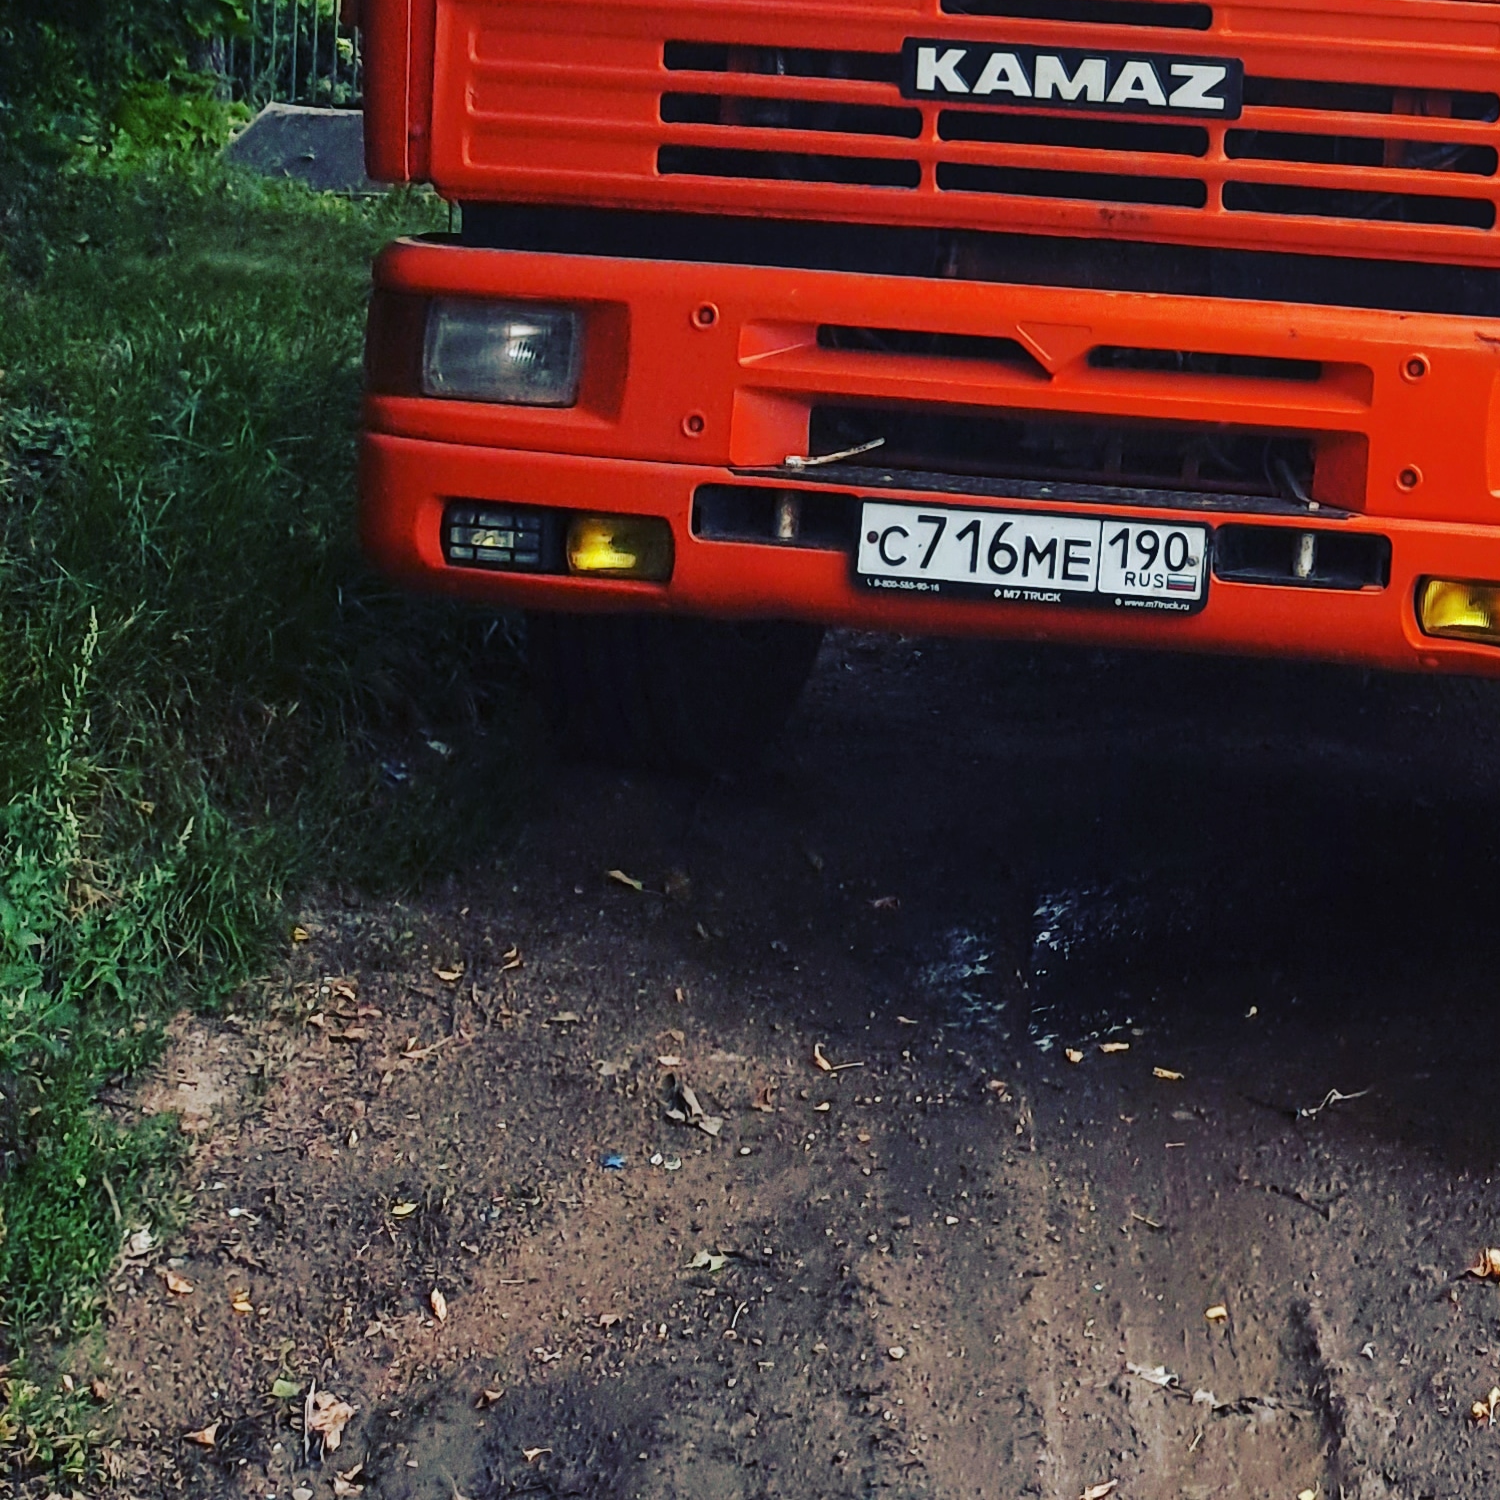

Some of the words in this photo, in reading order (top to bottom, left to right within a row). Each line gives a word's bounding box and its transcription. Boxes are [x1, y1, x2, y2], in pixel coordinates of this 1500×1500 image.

[916, 47, 1227, 110] KAMAZ
[1109, 527, 1189, 571] 190
[1125, 571, 1164, 589] RUS
[1003, 589, 1021, 600] M7
[1023, 590, 1062, 602] TRUCK
[1124, 599, 1190, 611] www.m7truck.ru
